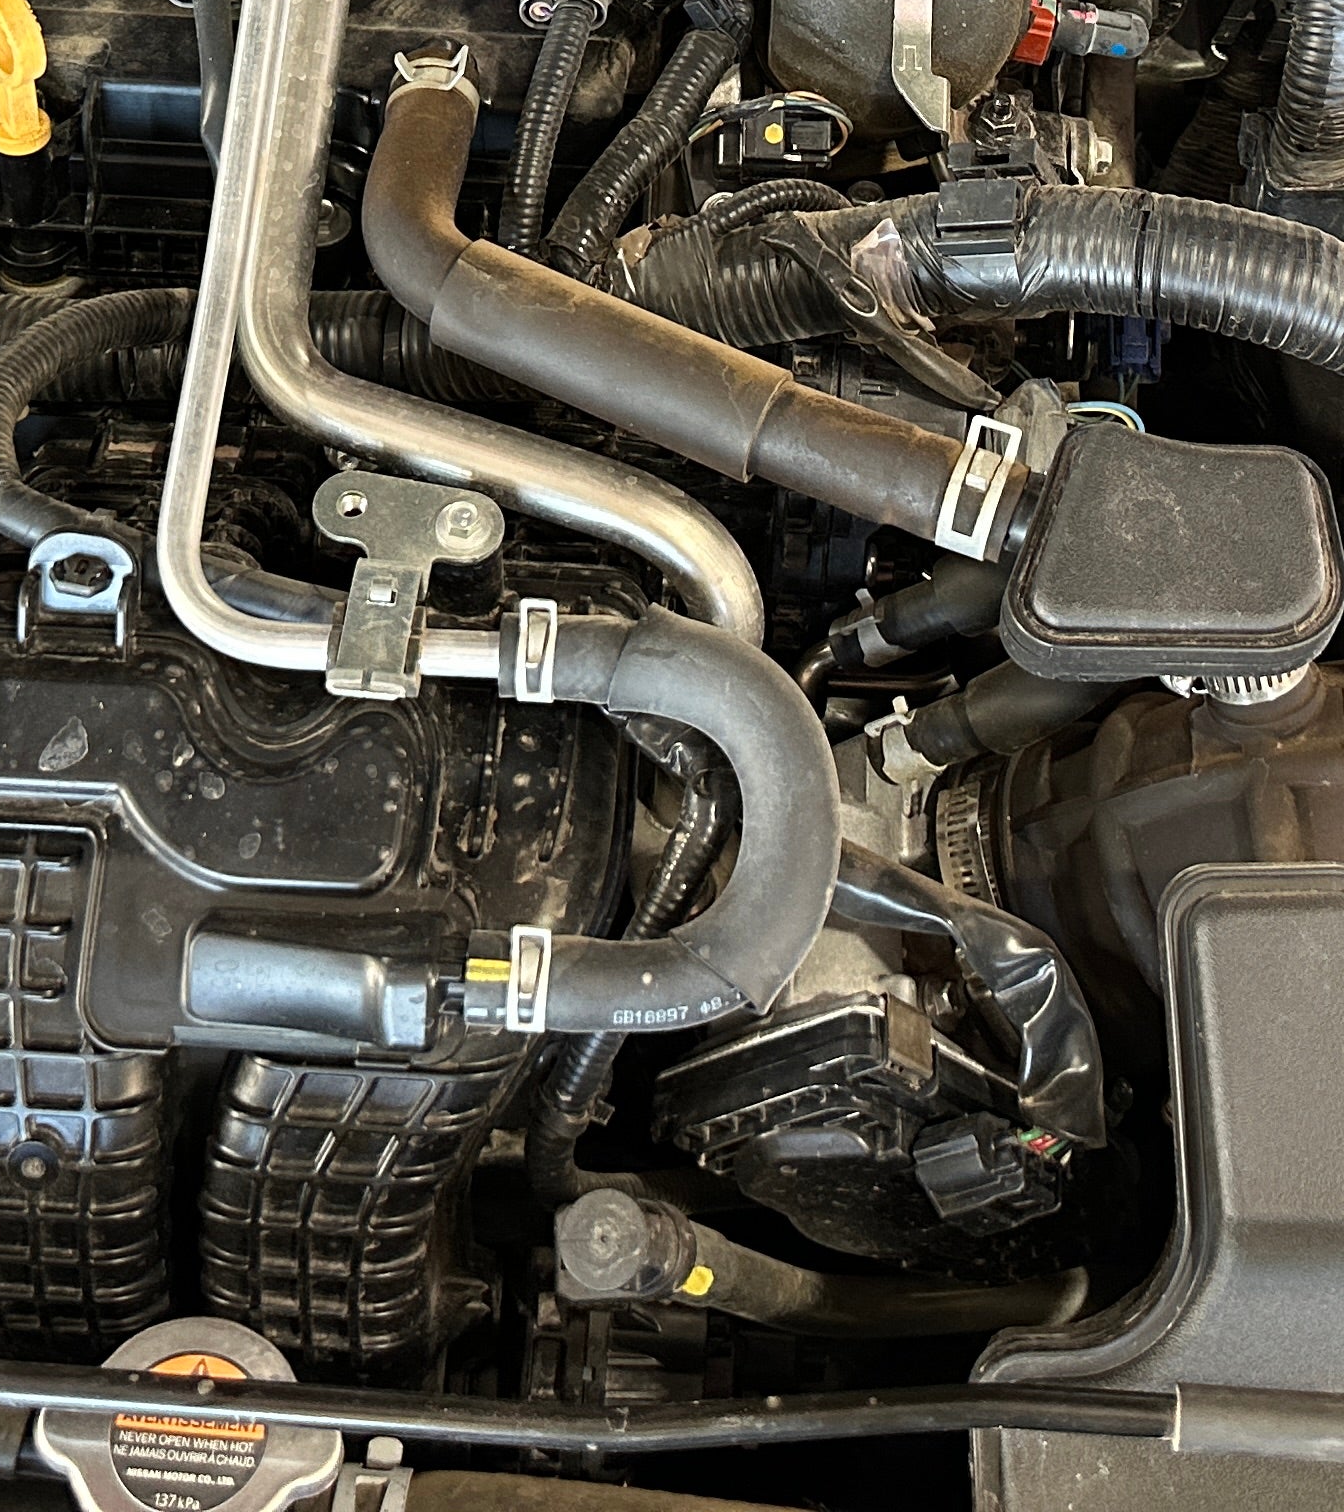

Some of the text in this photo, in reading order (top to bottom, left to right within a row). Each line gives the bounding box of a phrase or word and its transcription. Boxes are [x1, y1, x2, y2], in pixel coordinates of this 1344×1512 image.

[119, 1430, 156, 1443] NEVER
[159, 1434, 190, 1446] OPEN
[193, 1437, 228, 1450] WHEN
[113, 1444, 127, 1456] NE
[129, 1445, 166, 1459] JAMAIS
[167, 1449, 206, 1463] OUVRIR
[126, 1467, 161, 1479] NISSAN
[163, 1471, 196, 1483] MOTOR
[155, 1492, 201, 1510] 137 kPa
